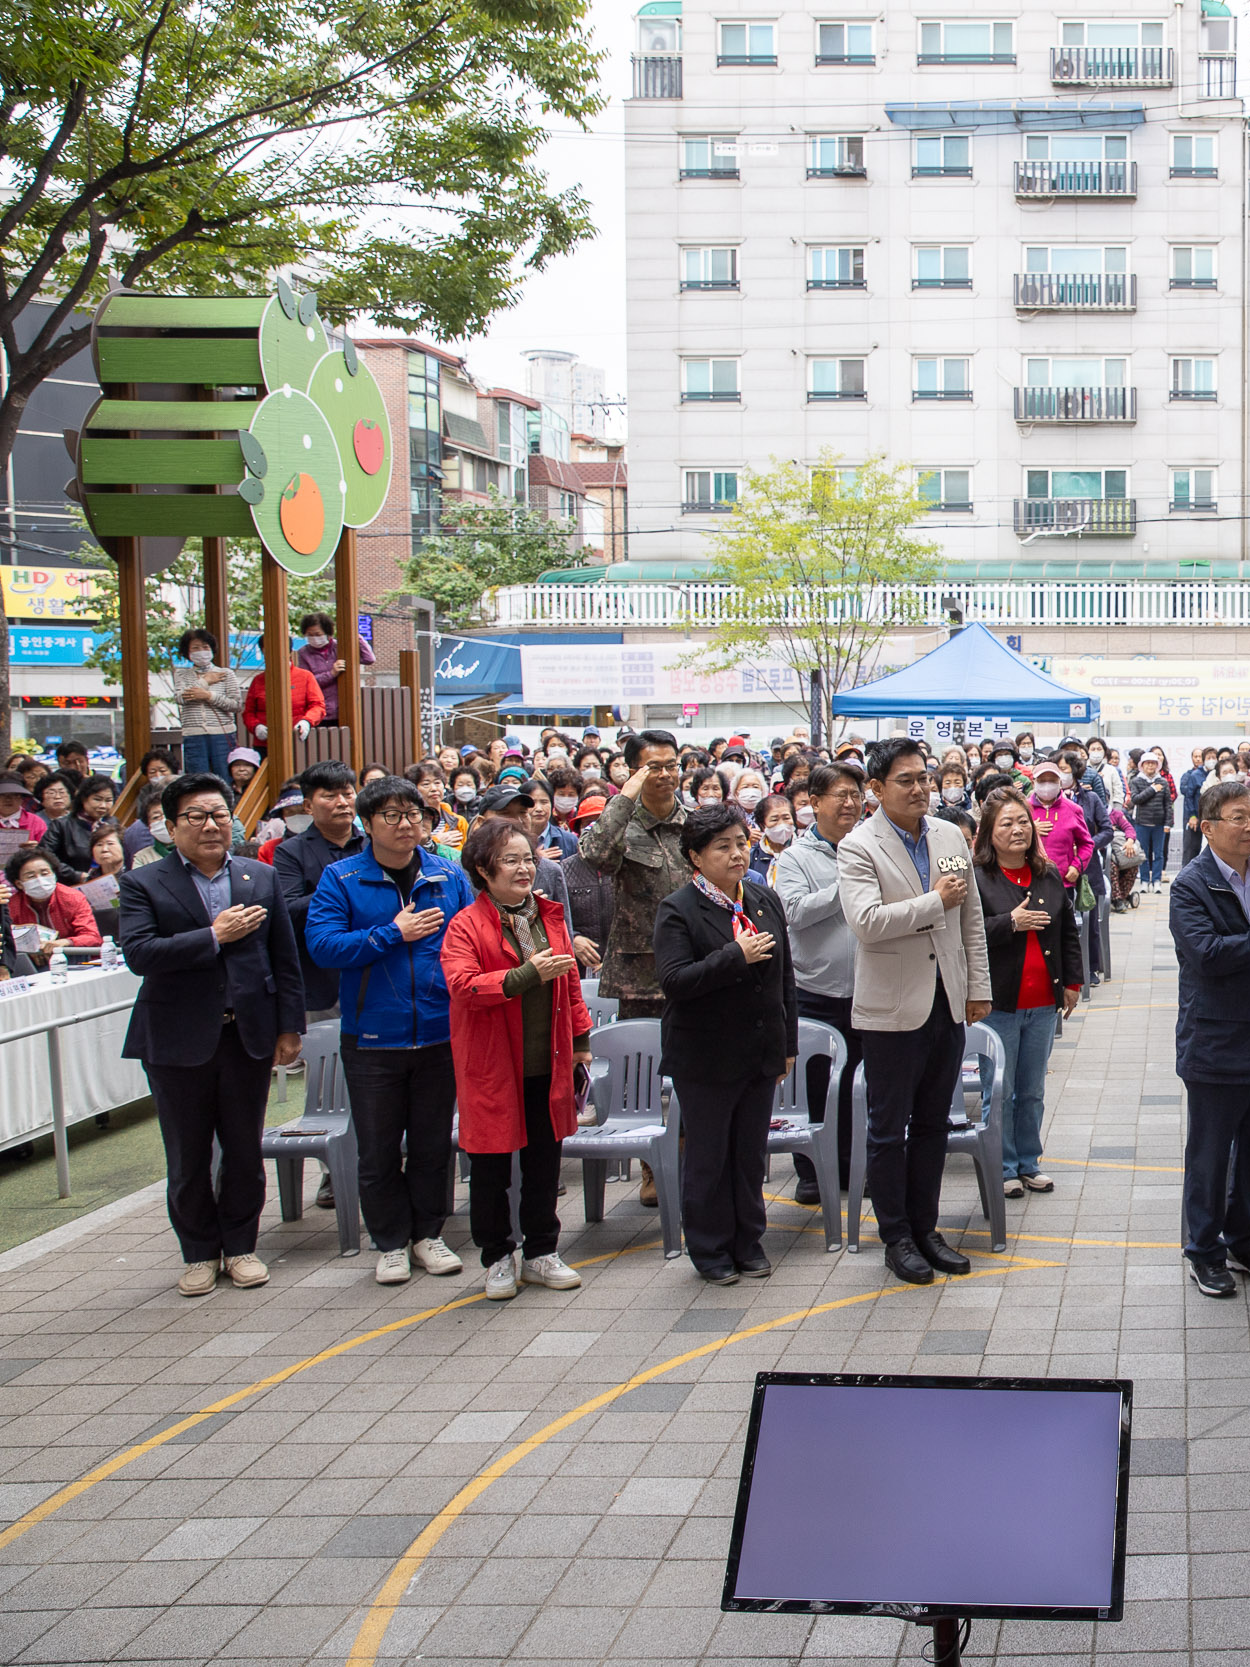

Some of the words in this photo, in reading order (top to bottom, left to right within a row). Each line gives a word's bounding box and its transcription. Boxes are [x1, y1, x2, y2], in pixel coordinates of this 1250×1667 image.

[12, 570, 49, 584] HD
[19, 636, 77, 648] 공인중개사
[909, 720, 1010, 738] 운영본부
[937, 855, 968, 873] 오신환
